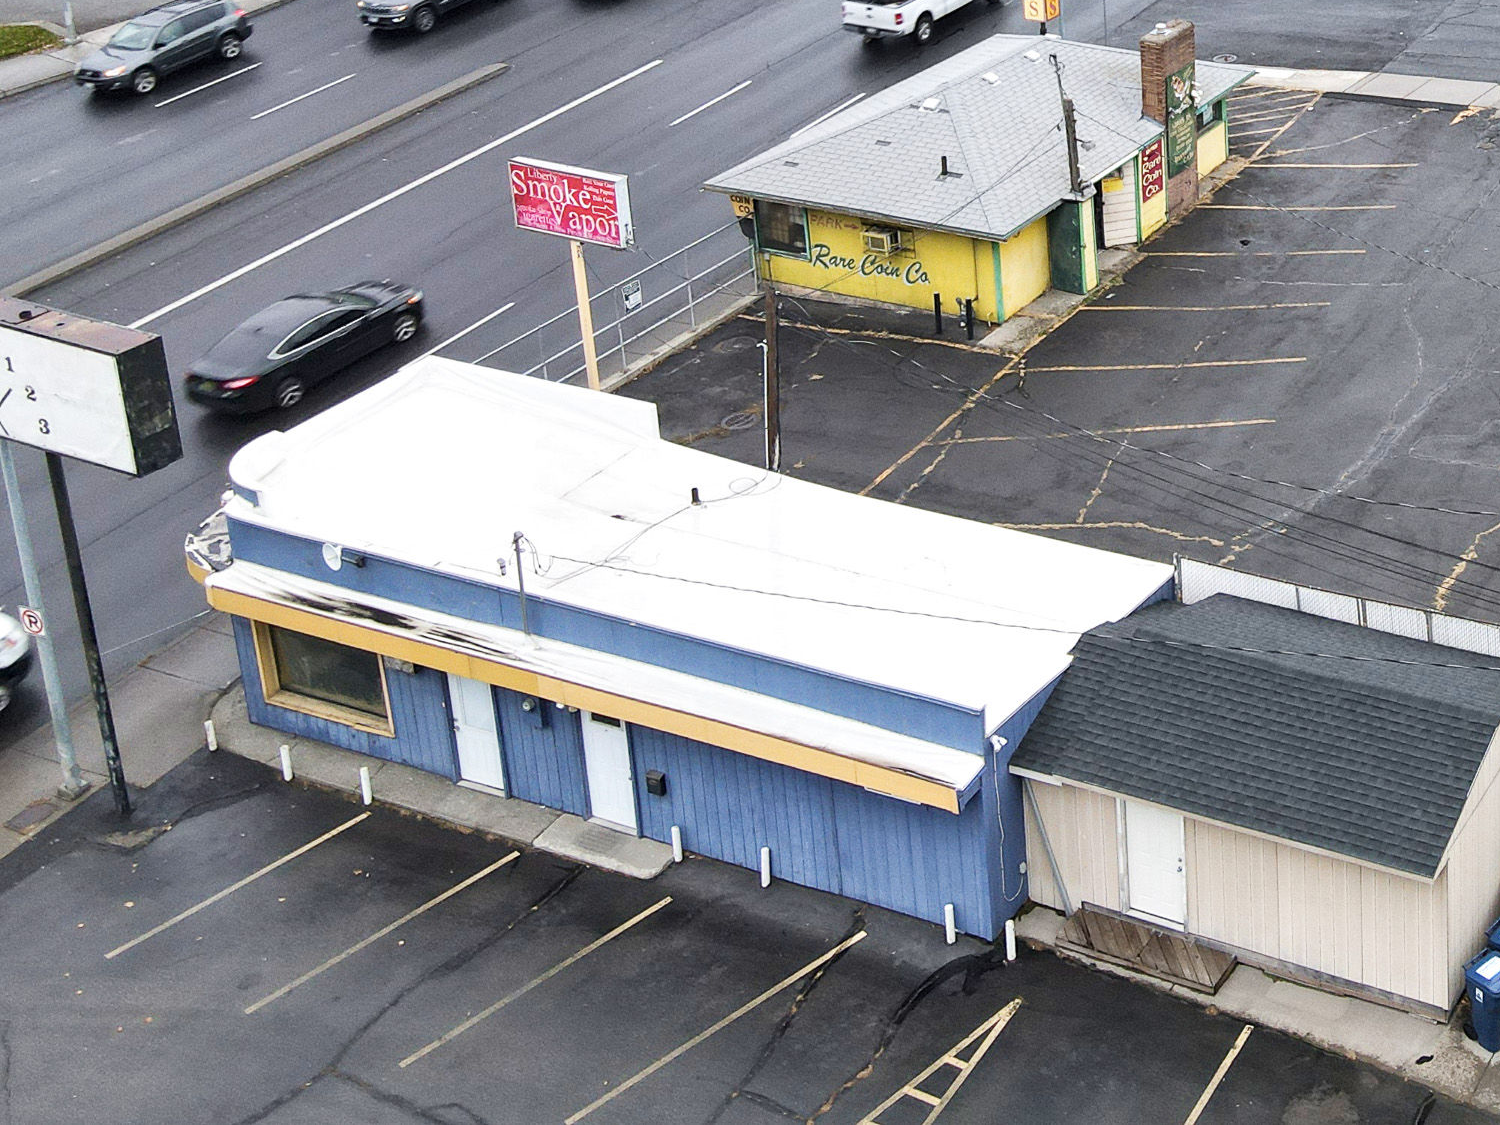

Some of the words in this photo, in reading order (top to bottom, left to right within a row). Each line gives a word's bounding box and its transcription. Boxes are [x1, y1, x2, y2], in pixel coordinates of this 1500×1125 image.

[527, 167, 558, 184] Liberty
[1143, 159, 1161, 175] Rare
[1143, 170, 1162, 186] Coin
[511, 169, 592, 209] Smoke
[730, 195, 751, 206] COIN
[550, 200, 619, 239] Vapor
[810, 213, 844, 230] PARK
[811, 243, 856, 270] Rare
[860, 254, 902, 278] Coin
[5, 356, 15, 373] 1
[25, 385, 37, 402] 2
[39, 418, 50, 435] 3
